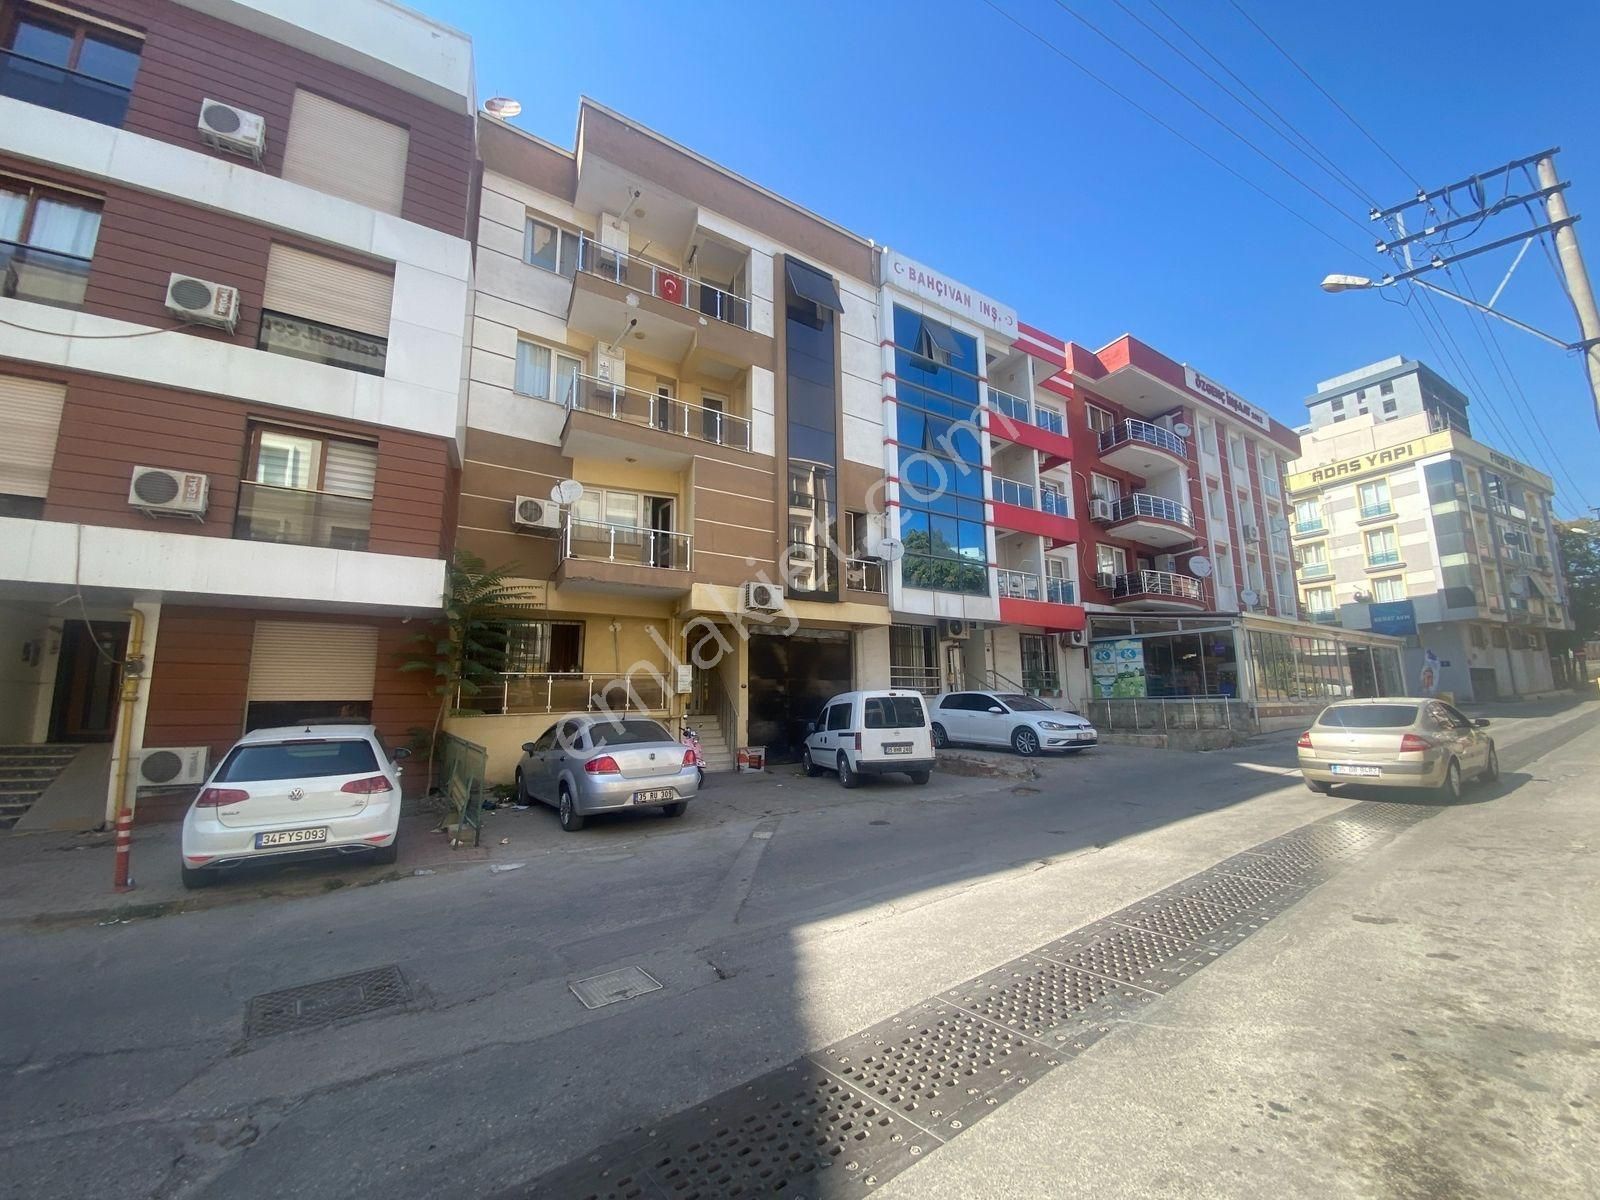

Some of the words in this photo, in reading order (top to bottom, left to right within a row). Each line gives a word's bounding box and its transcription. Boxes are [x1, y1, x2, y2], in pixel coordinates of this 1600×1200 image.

[908, 267, 971, 308] BAHÇIVAN
[1311, 459, 1362, 483] ADAŞ
[1365, 444, 1414, 466] YAPI
[638, 792, 647, 801] 35
[262, 829, 326, 846] 34FYS093
